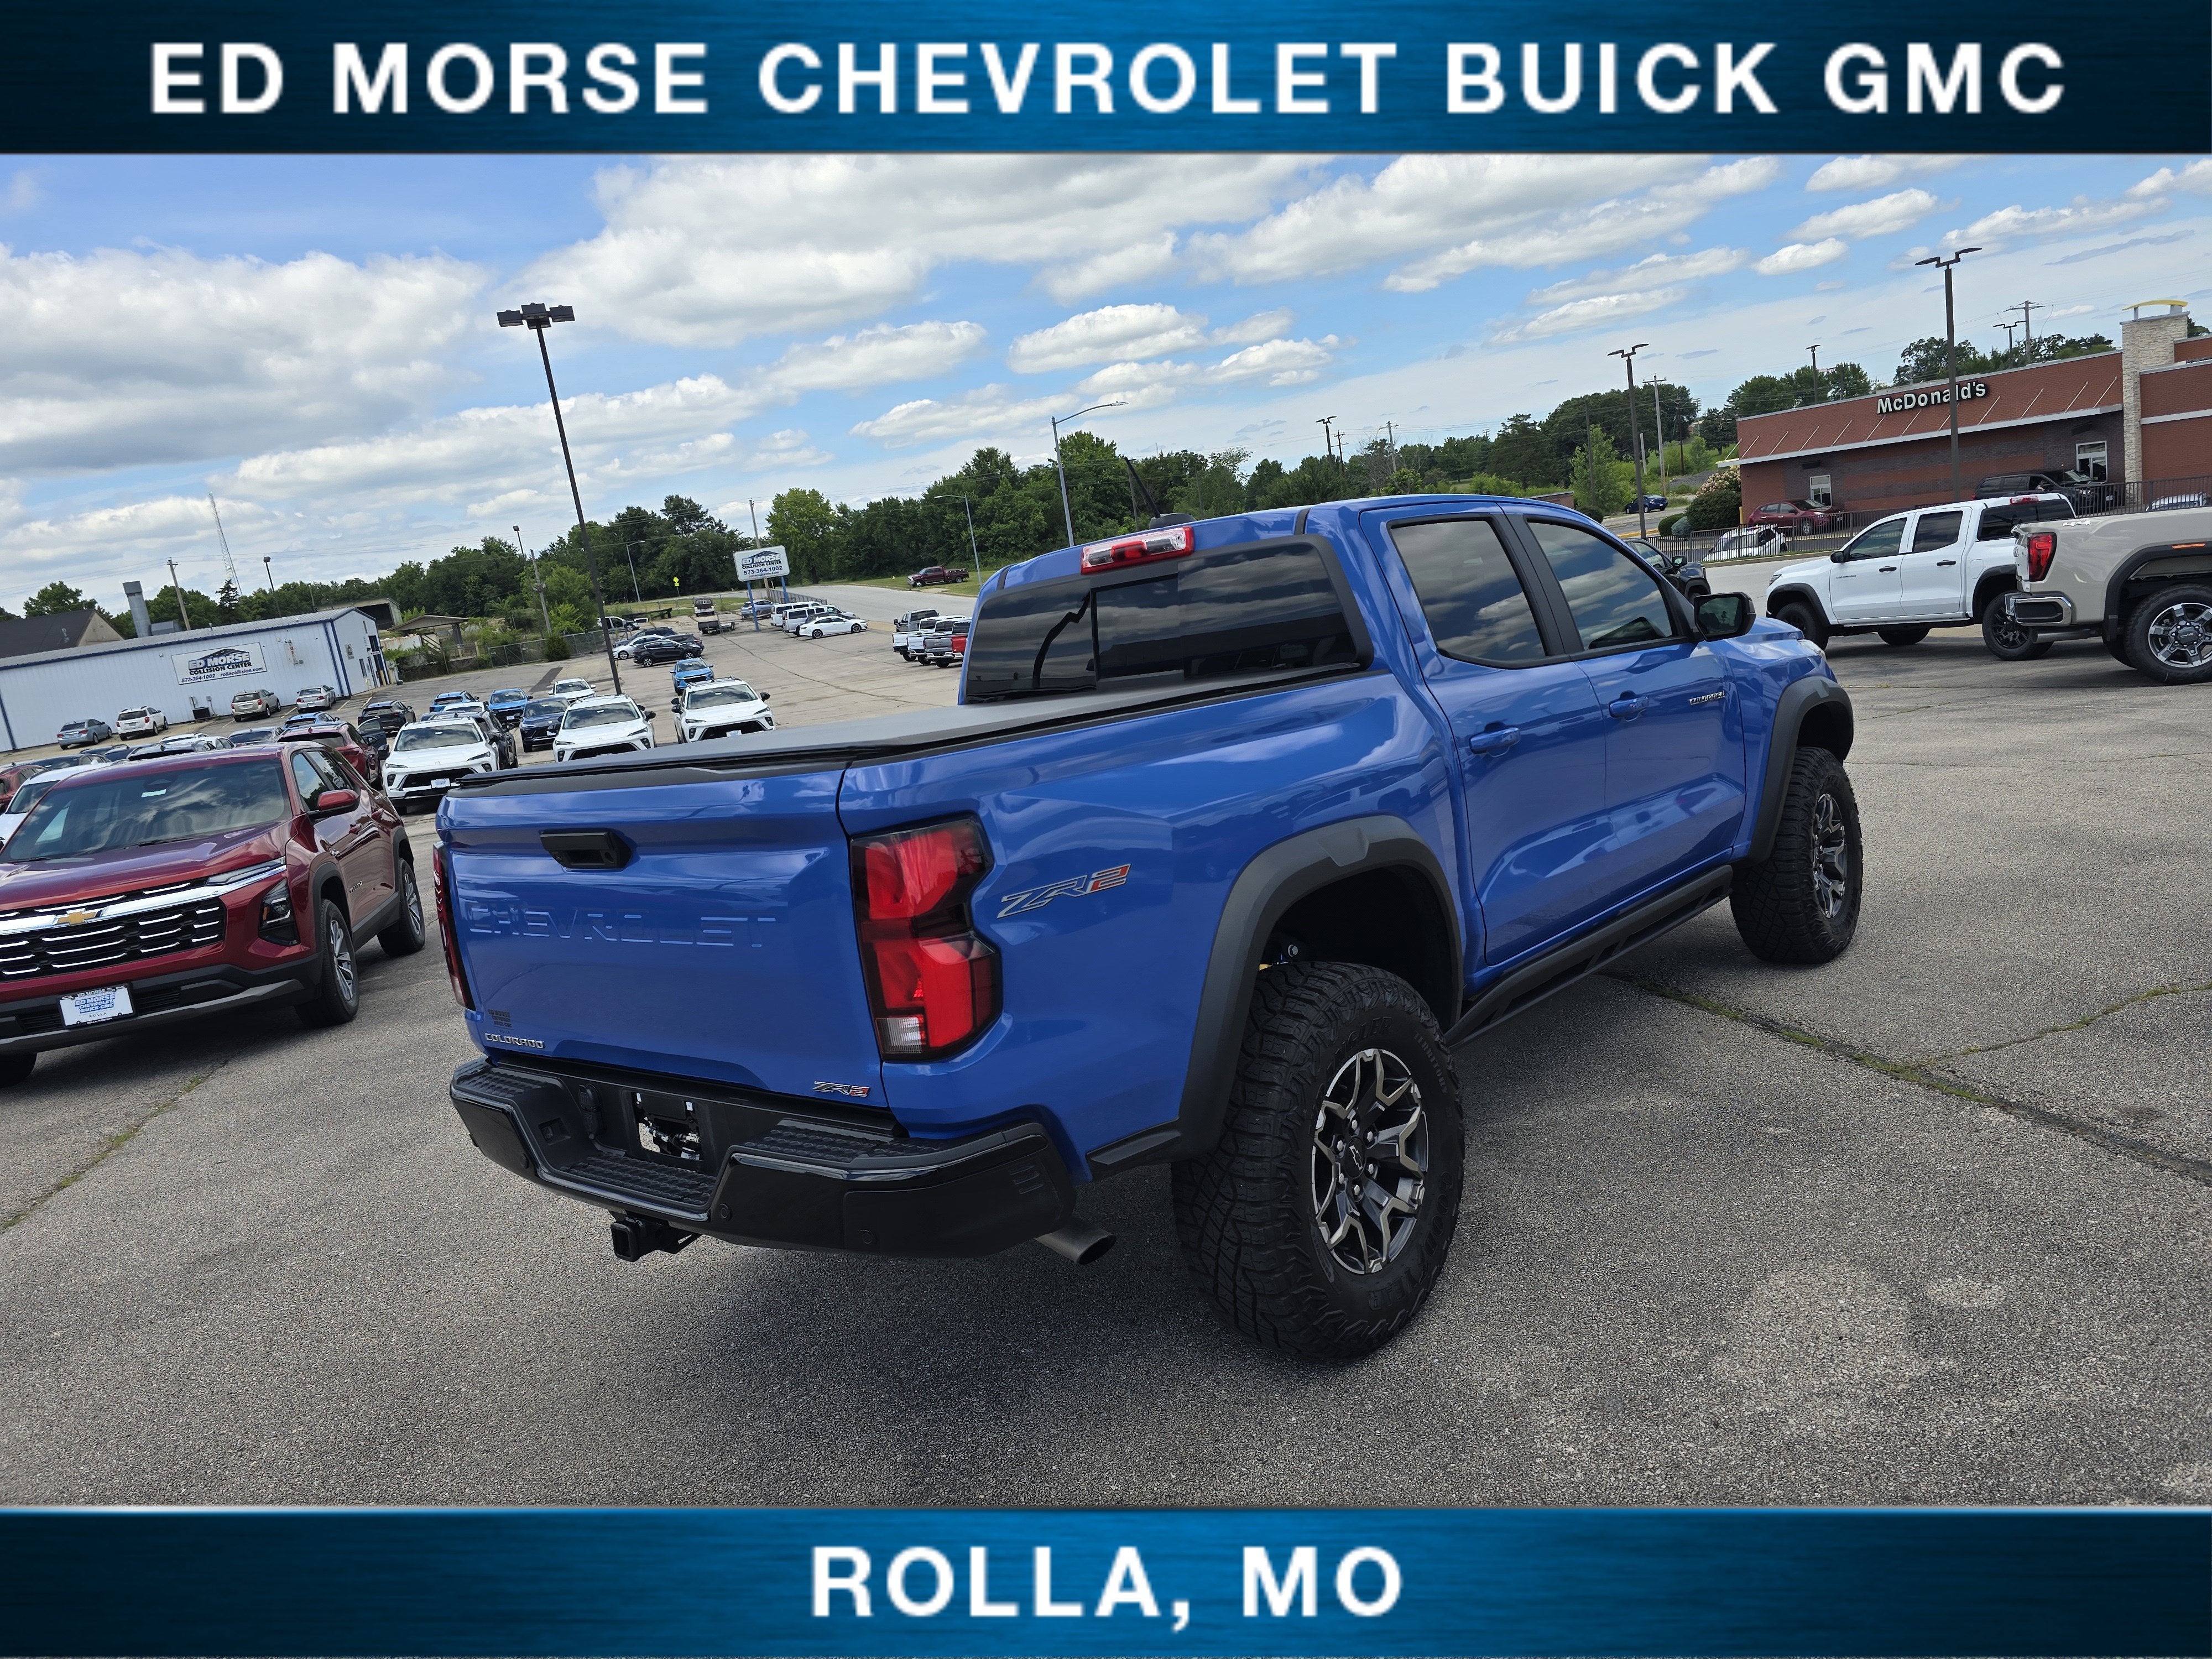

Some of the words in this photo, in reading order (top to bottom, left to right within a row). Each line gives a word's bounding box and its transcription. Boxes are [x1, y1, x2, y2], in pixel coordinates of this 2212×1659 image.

[1877, 382, 1986, 414] McDonald's
[753, 554, 780, 564] MORSE
[744, 565, 782, 575] 573-364-1002
[189, 660, 205, 670] ED
[207, 652, 250, 667] MORSE
[189, 665, 226, 676] COLLISION
[227, 662, 253, 670] CENTER
[181, 674, 216, 683] 573-364-1002
[221, 667, 263, 677] rollacollision.com
[997, 863, 1131, 919] ZR2
[467, 902, 775, 947] CHEVROLET
[86, 993, 115, 1004] MORSE
[485, 1032, 544, 1048] COLORADO
[812, 1081, 870, 1097] ZR2
